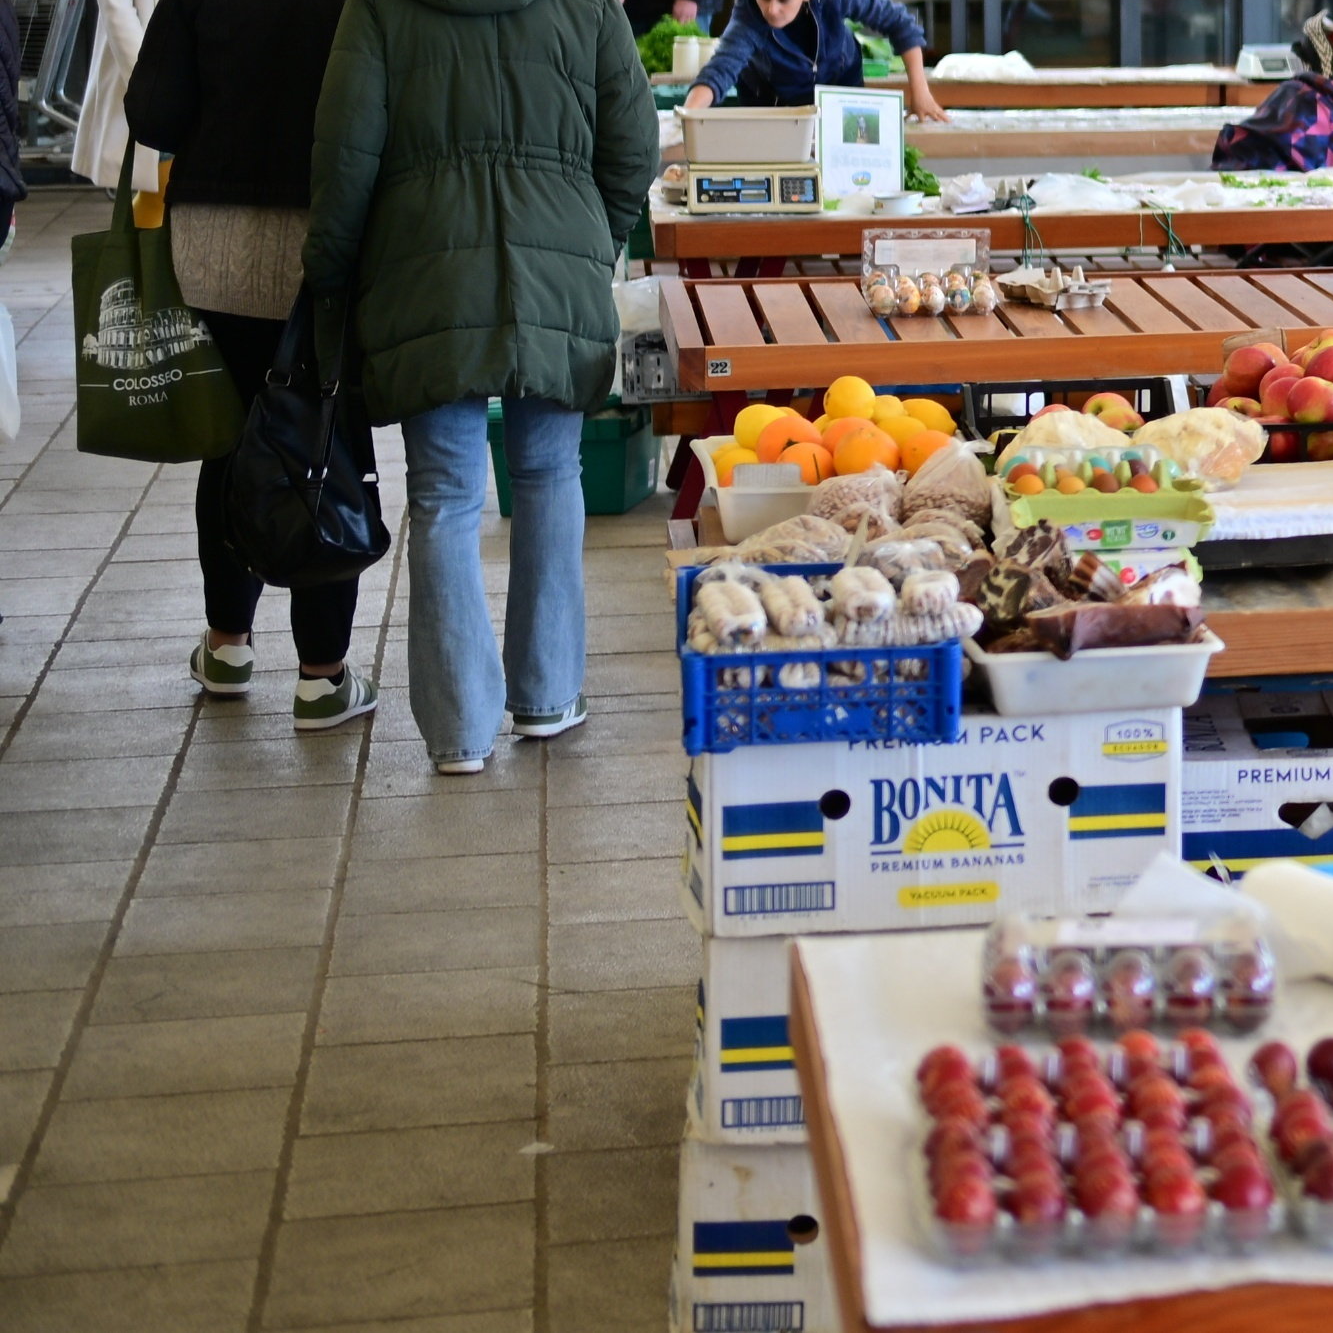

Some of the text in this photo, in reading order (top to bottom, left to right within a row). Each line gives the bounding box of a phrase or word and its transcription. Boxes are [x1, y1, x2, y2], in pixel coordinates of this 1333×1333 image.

[710, 361, 728, 374] 22
[113, 368, 183, 391] COLOSSEO
[129, 391, 169, 407] ROMA
[979, 723, 1046, 745] PACK
[1116, 728, 1154, 740] 100%
[1237, 767, 1331, 784] PREMIUM
[869, 771, 1025, 846] BONITA
[870, 853, 1026, 873] PREMIUM BANANAS
[909, 886, 989, 901] VACUUM PACK
